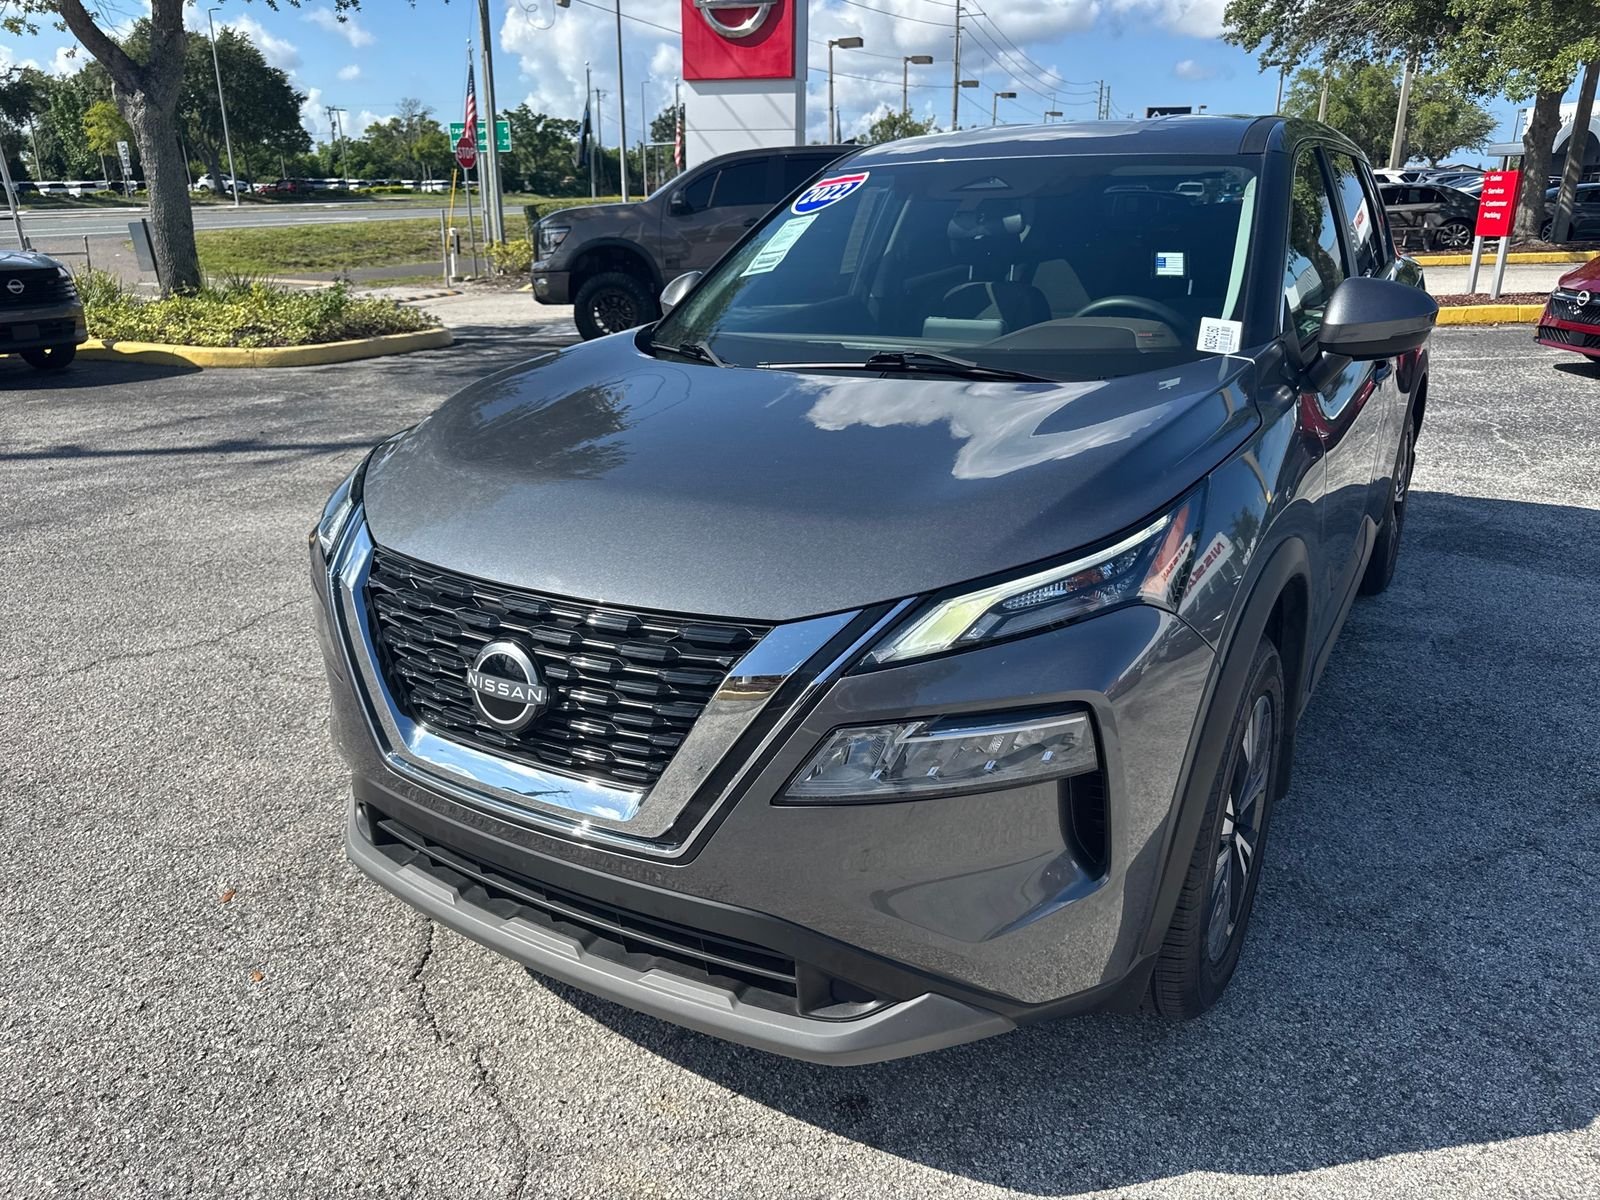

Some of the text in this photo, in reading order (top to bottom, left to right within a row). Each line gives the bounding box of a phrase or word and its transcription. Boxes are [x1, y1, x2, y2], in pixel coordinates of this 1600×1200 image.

[457, 147, 476, 159] STOP
[798, 183, 853, 205] 2022
[1483, 212, 1502, 220] Parking
[468, 671, 542, 702] NISSAN
